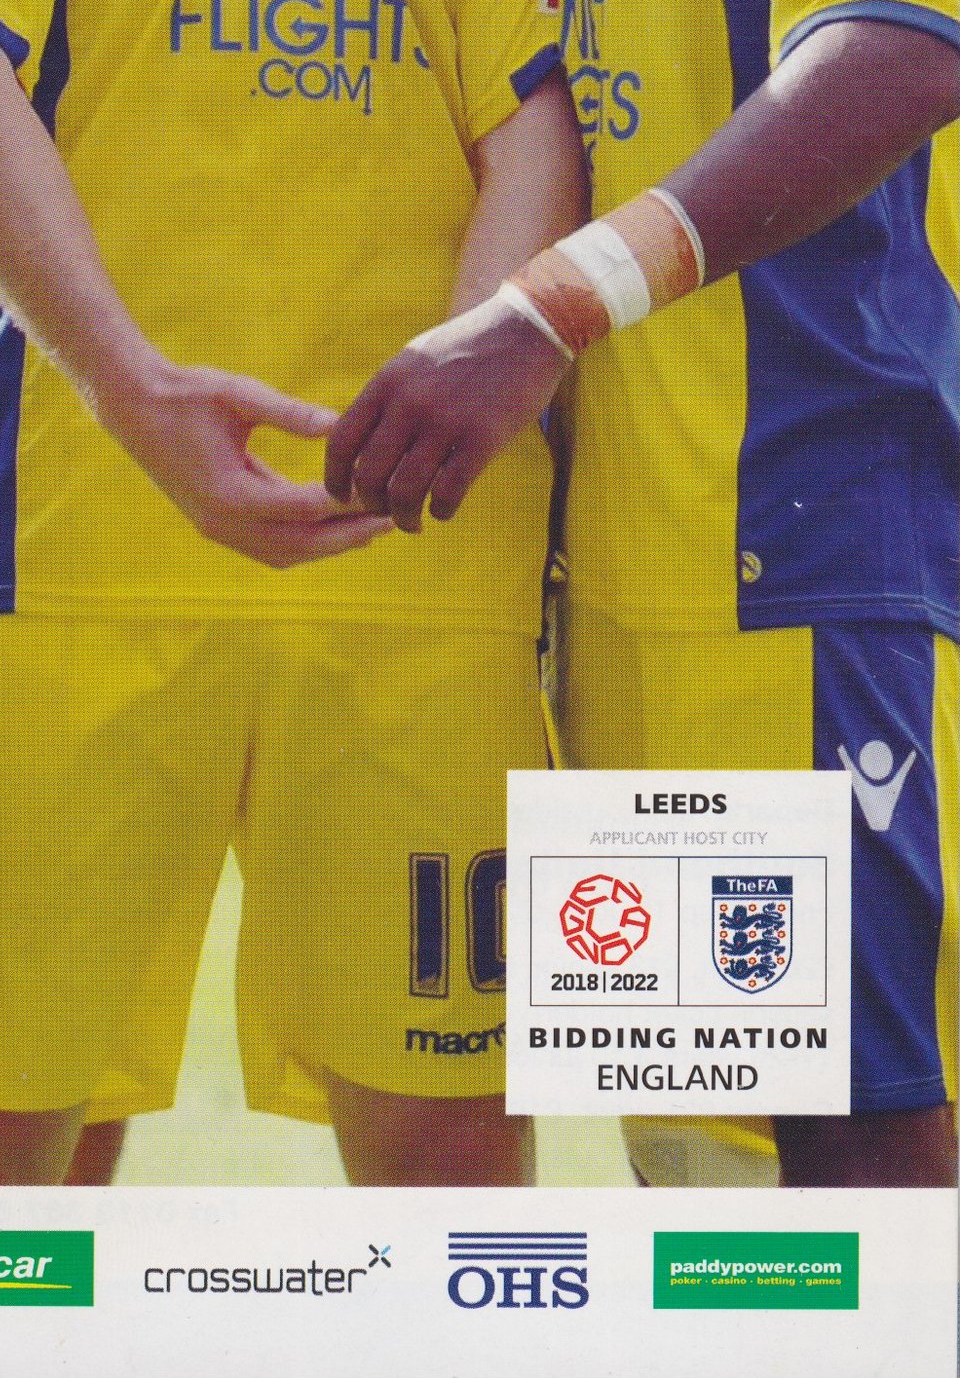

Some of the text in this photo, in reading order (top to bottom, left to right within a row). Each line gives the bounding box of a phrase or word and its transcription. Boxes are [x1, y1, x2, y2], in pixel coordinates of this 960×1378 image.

[635, 793, 728, 816] LEEDS
[589, 830, 769, 846] APPLICANT HOST CITY
[530, 1027, 828, 1051] BIDDING NATION
[598, 1065, 759, 1092] ENGLAND
[144, 1260, 367, 1297] crosswater
[670, 1259, 842, 1276] paddypower.com
[448, 1267, 591, 1311] OHS
[670, 1276, 842, 1287] poker casino betting games
